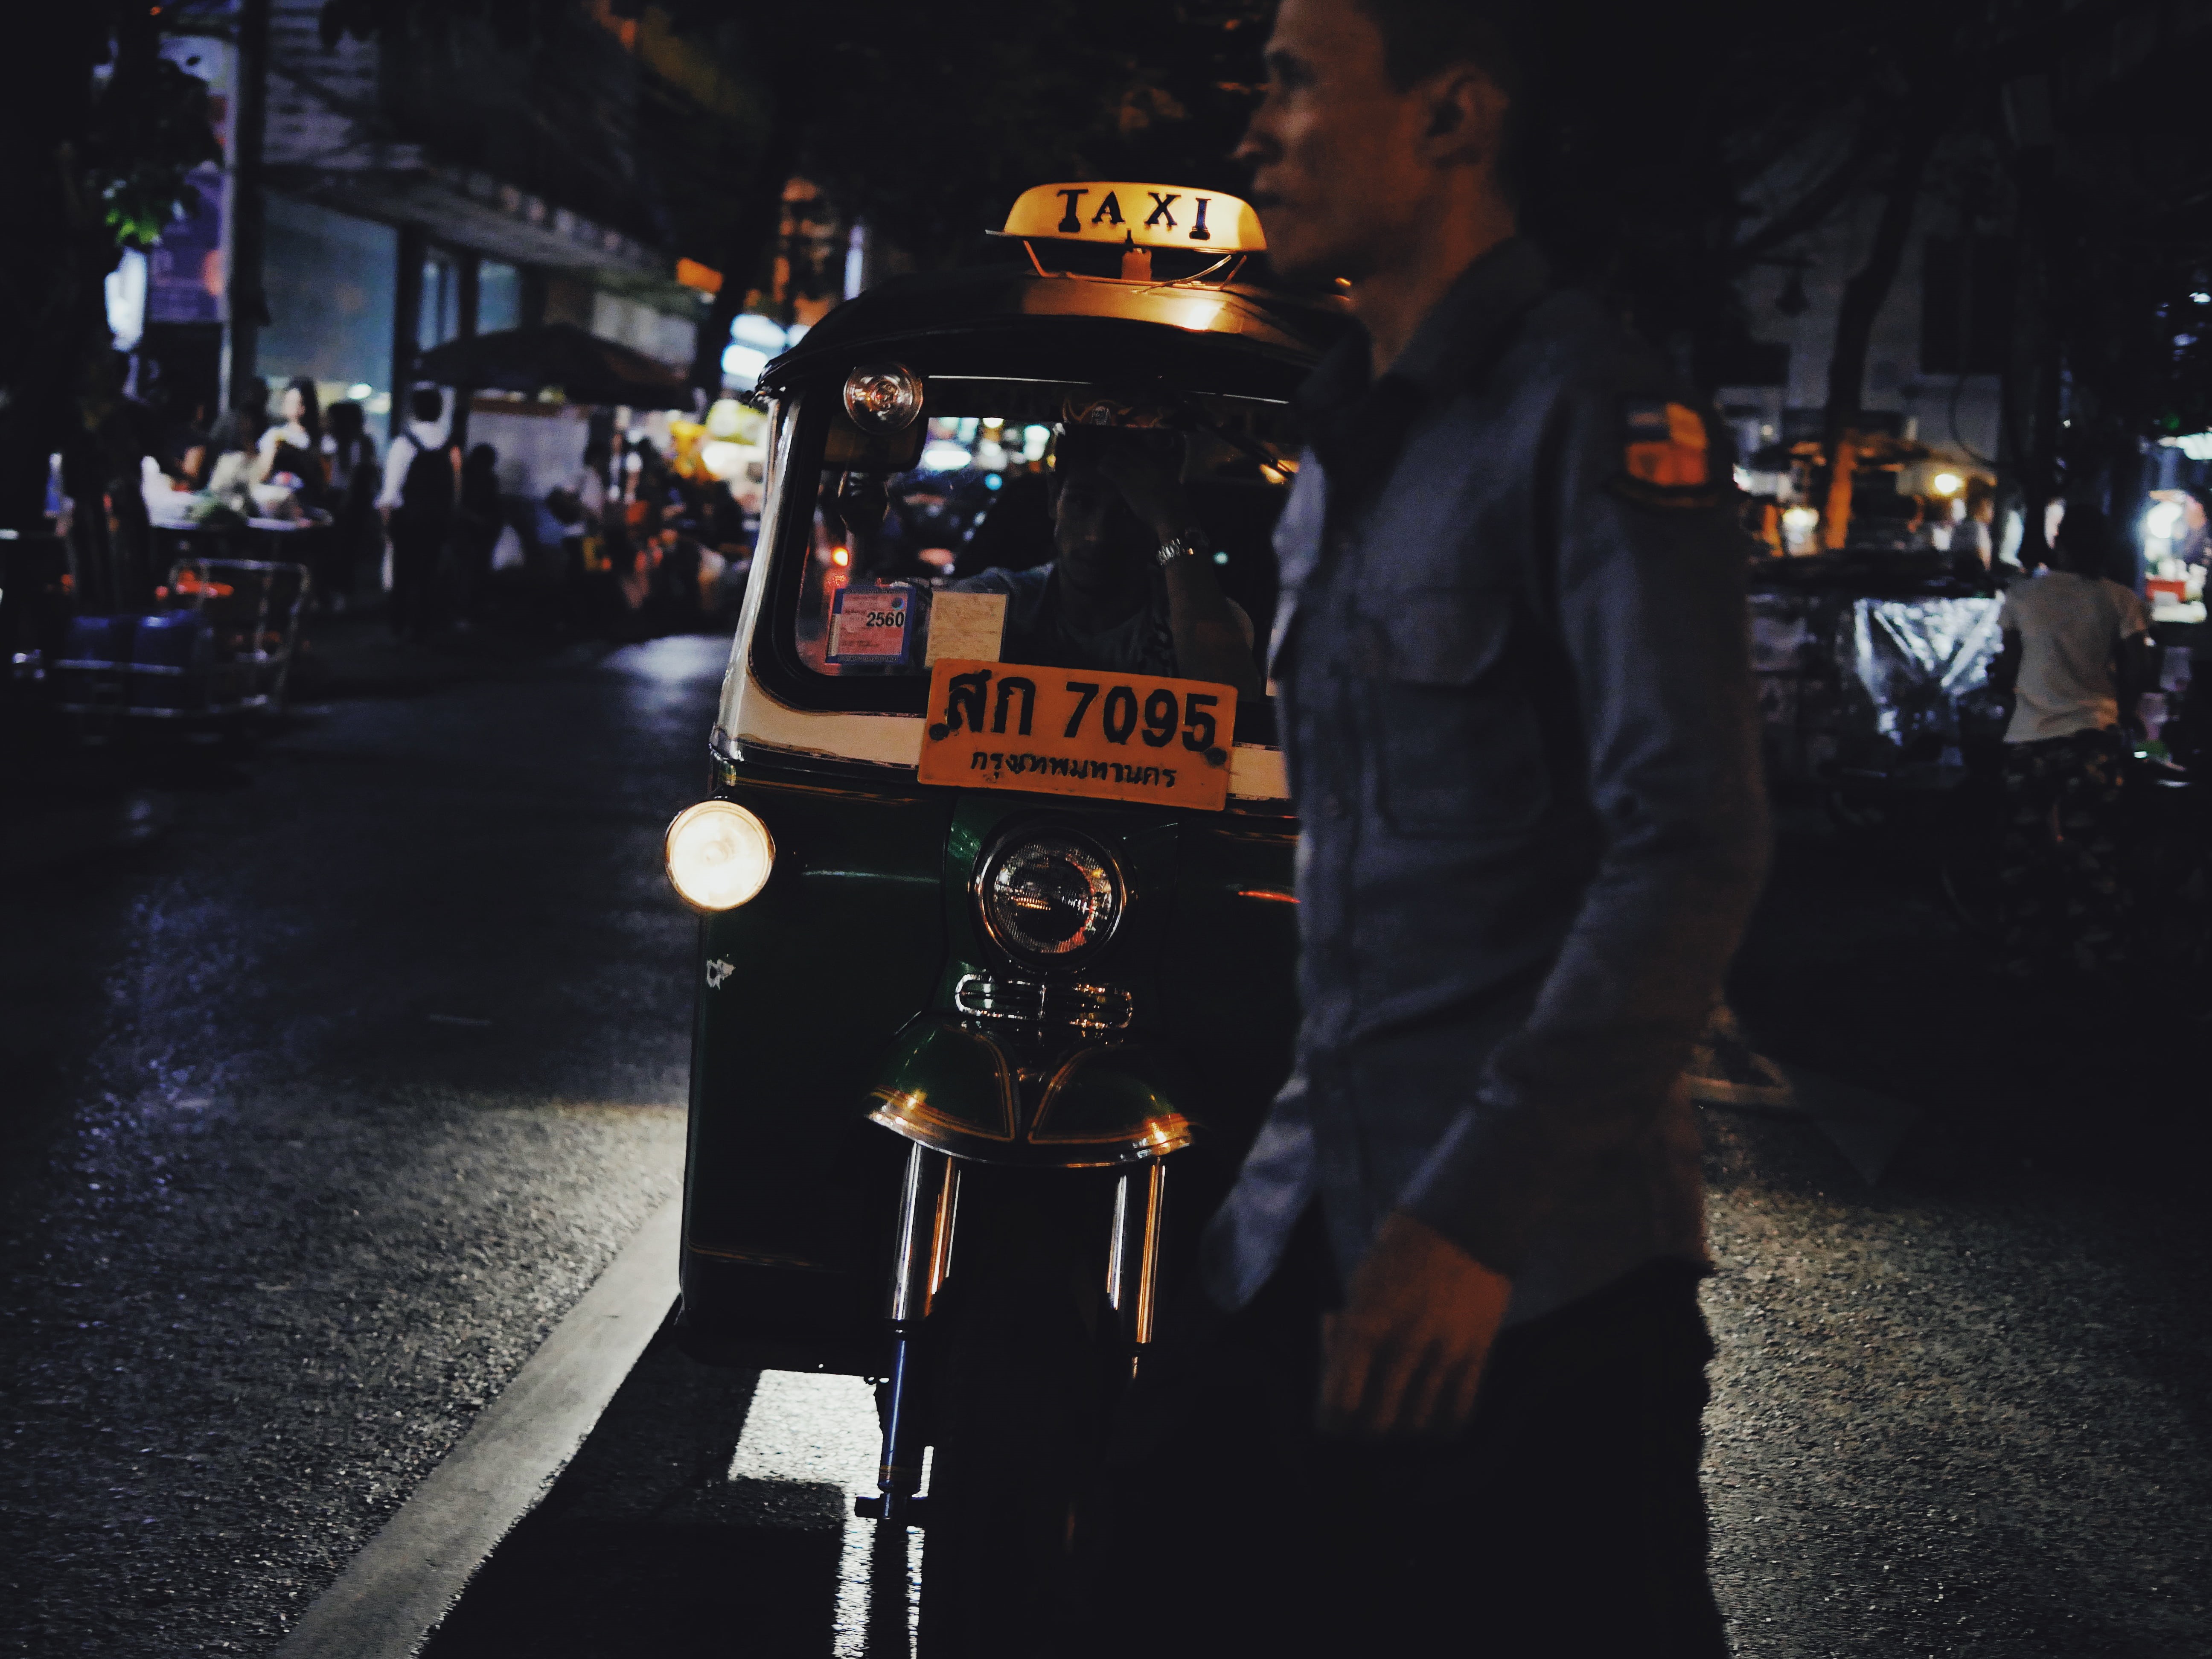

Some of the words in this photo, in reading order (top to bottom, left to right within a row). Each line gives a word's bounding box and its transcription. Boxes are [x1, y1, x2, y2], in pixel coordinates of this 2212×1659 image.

[1057, 189, 1211, 240] TAXI
[866, 611, 904, 627] 2560
[946, 669, 1036, 736] สก
[1064, 681, 1217, 752] 7095
[971, 752, 1176, 788] กรุงเทพมหานคร
